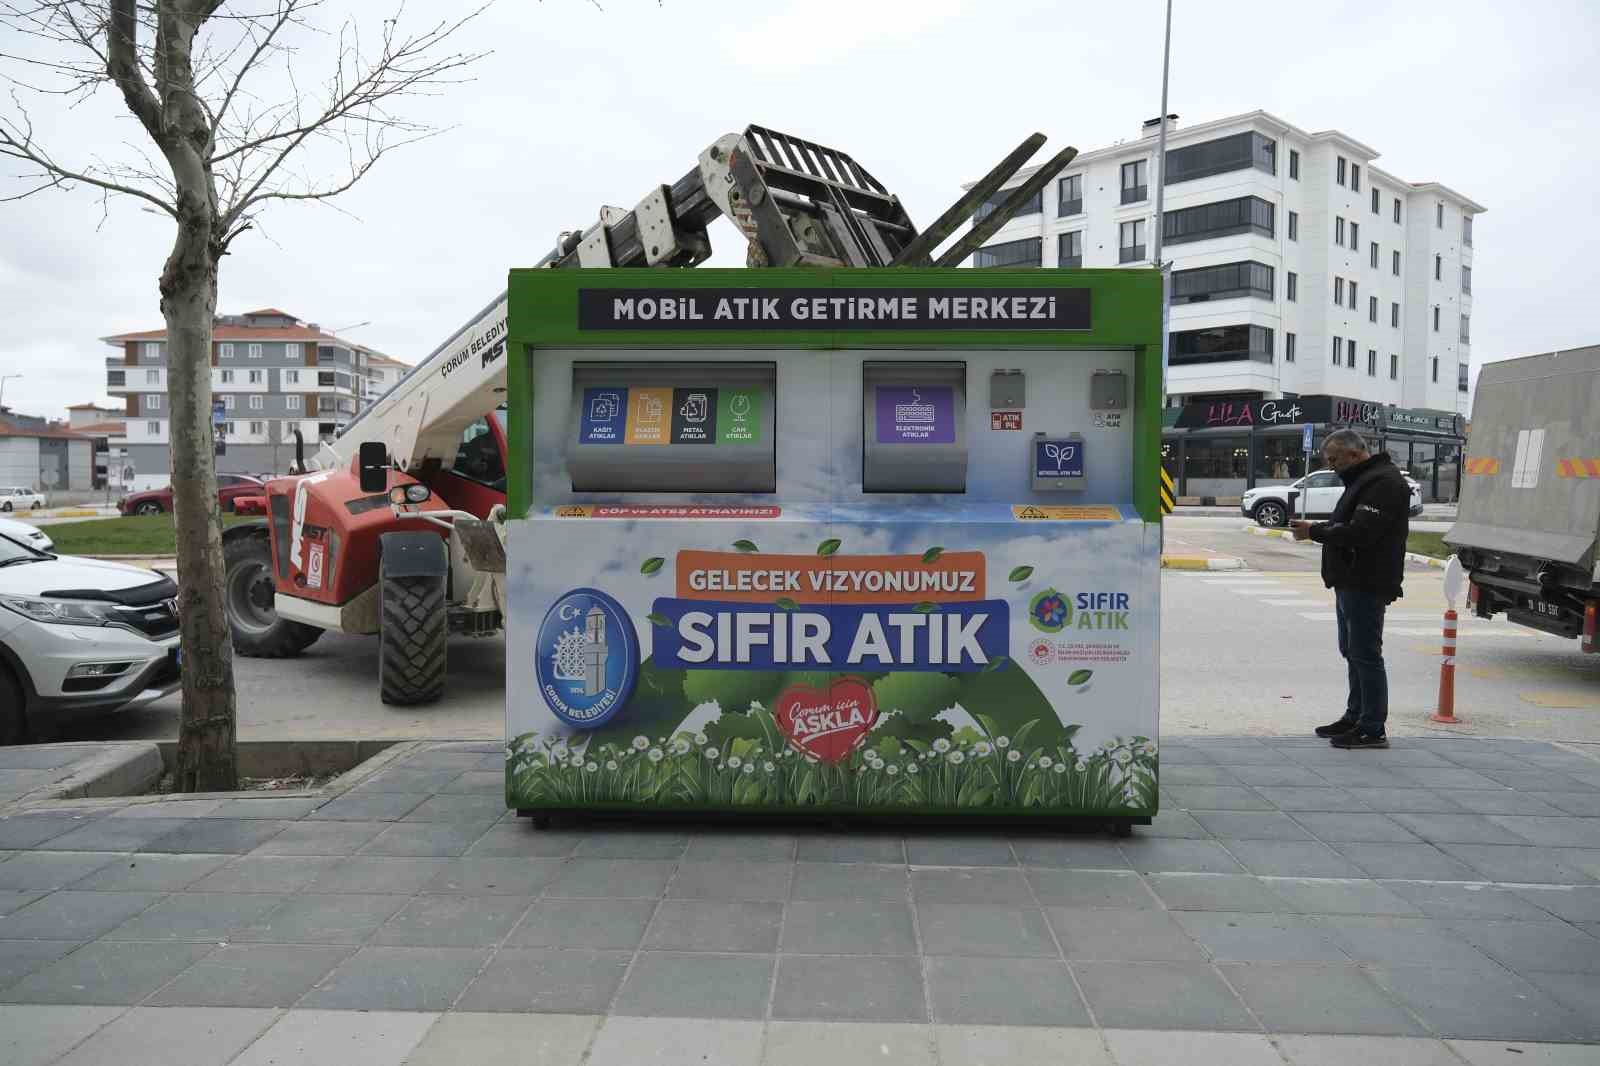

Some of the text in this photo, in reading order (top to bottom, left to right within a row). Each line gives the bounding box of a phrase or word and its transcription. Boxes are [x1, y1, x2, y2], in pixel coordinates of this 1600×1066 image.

[714, 298, 780, 320] ATIK
[688, 570, 802, 592] GELECEK
[1076, 592, 1130, 610] SIFIR
[1077, 611, 1129, 630] ATIK
[676, 611, 990, 665] SIFIR ATIK
